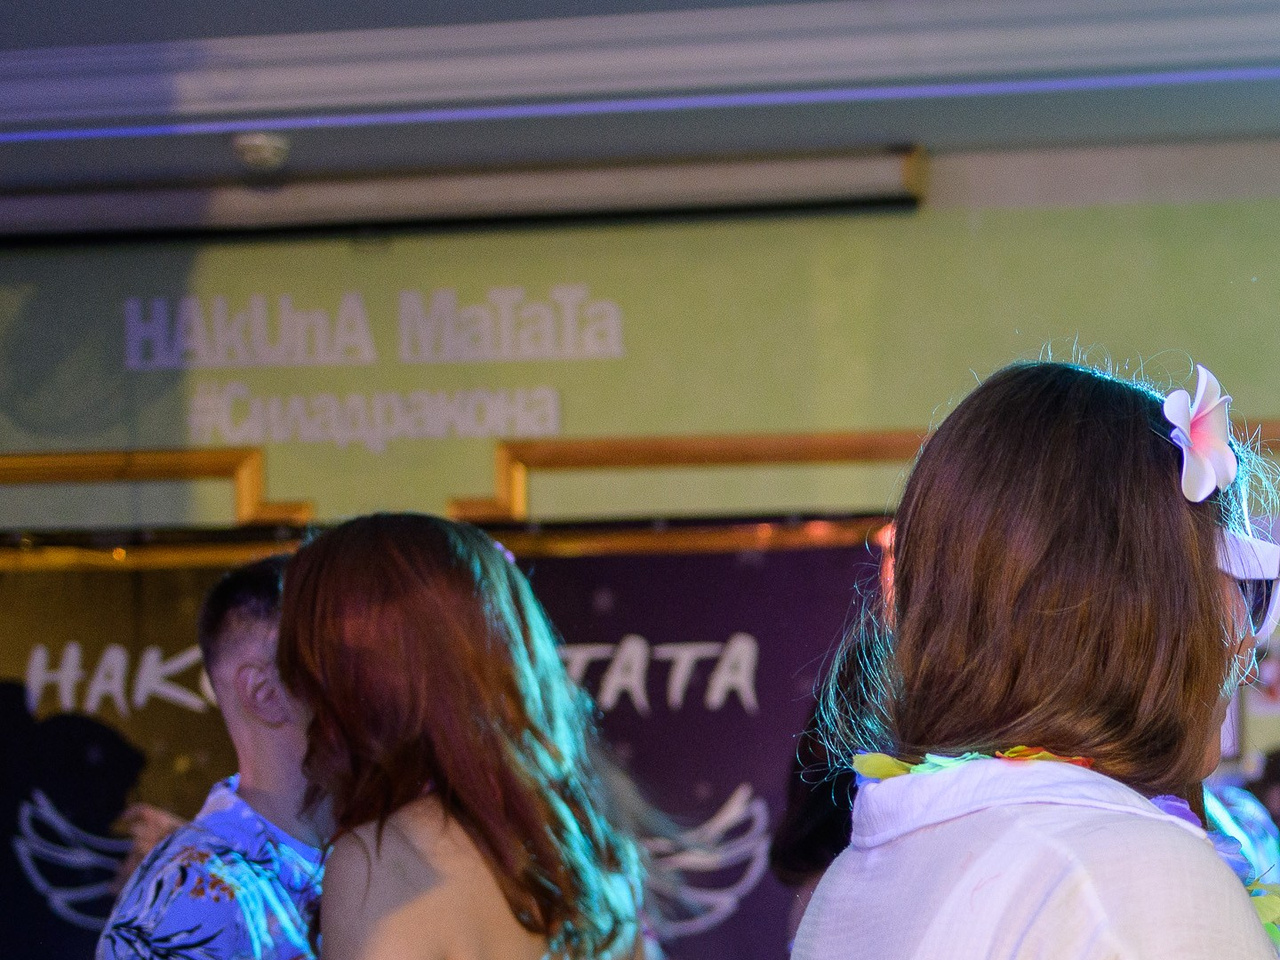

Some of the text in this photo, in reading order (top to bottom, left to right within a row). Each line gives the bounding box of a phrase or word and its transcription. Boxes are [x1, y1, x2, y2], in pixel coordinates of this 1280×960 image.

[400, 284, 626, 363] MaTaTa
[25, 633, 760, 718] HAK TATA
